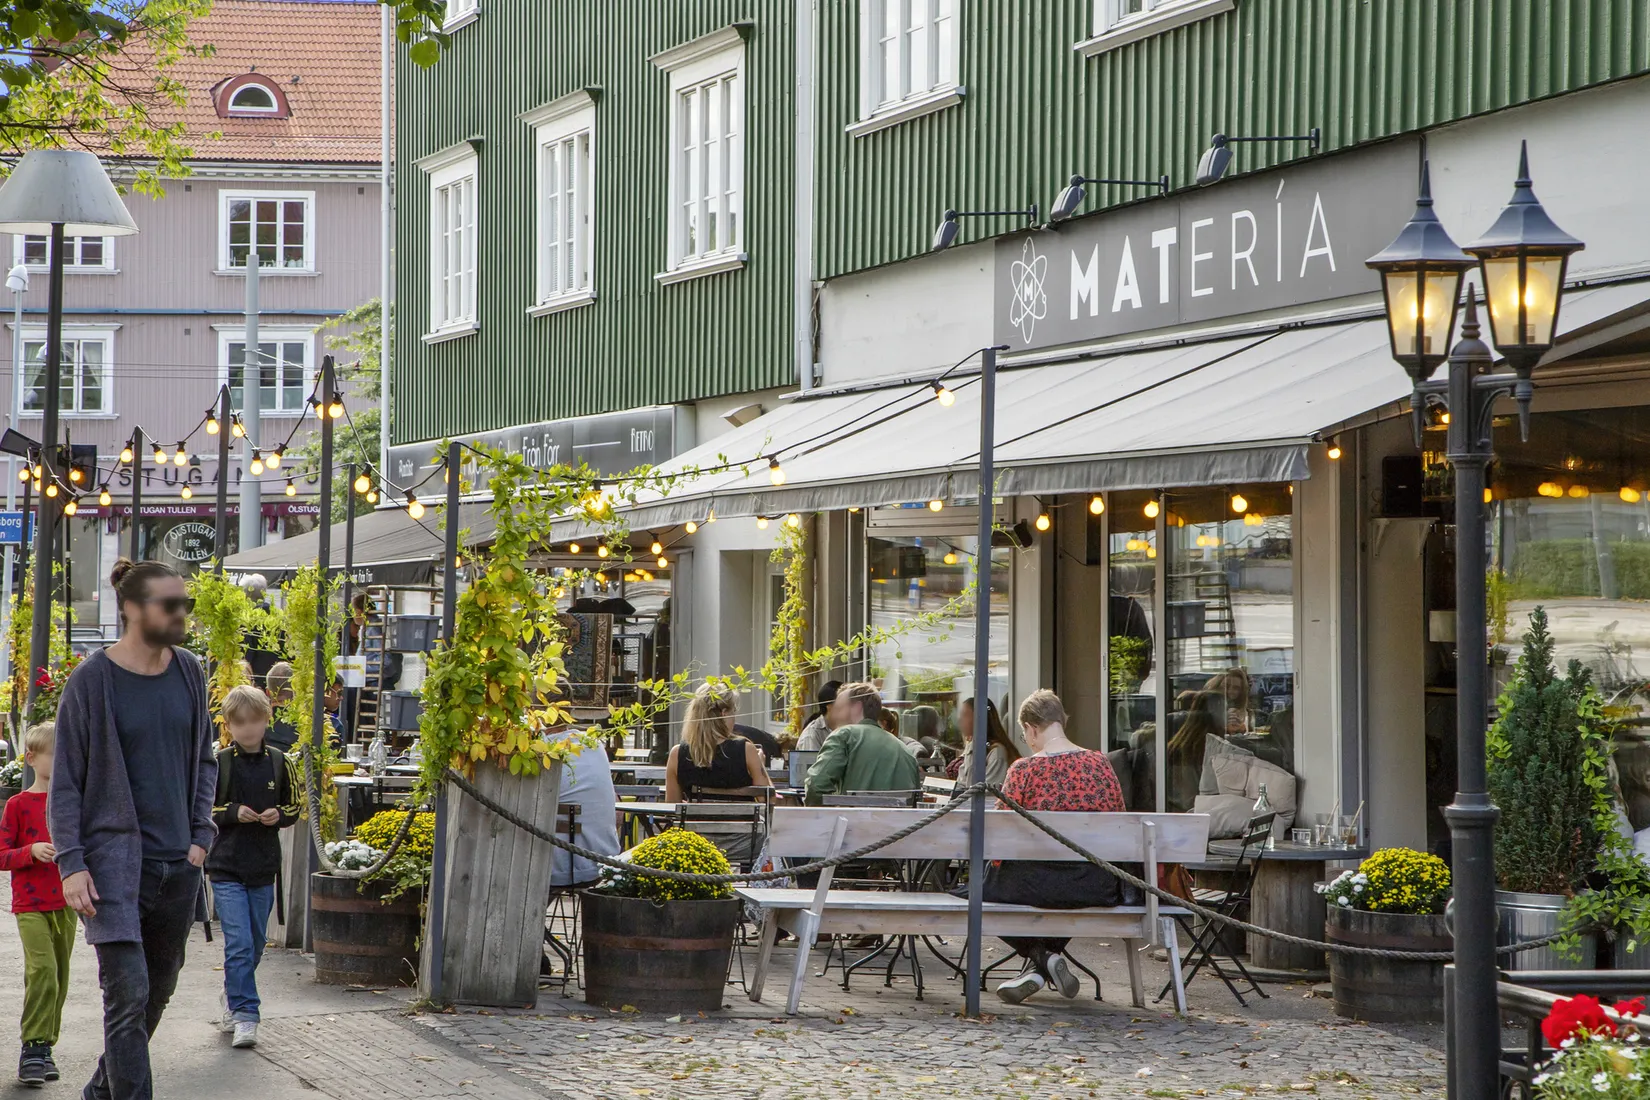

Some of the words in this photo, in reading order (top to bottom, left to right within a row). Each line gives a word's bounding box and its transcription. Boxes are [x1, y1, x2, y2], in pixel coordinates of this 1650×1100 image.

[1069, 178, 1337, 321] MATERÍA
[1024, 279, 1034, 302] M
[522, 436, 541, 467] Från
[543, 433, 560, 466] Förr
[630, 427, 654, 453] RETRO
[123, 505, 166, 514] ÖLTUGAN
[167, 506, 197, 514] TULLEN
[176, 548, 208, 560] TULLEN
